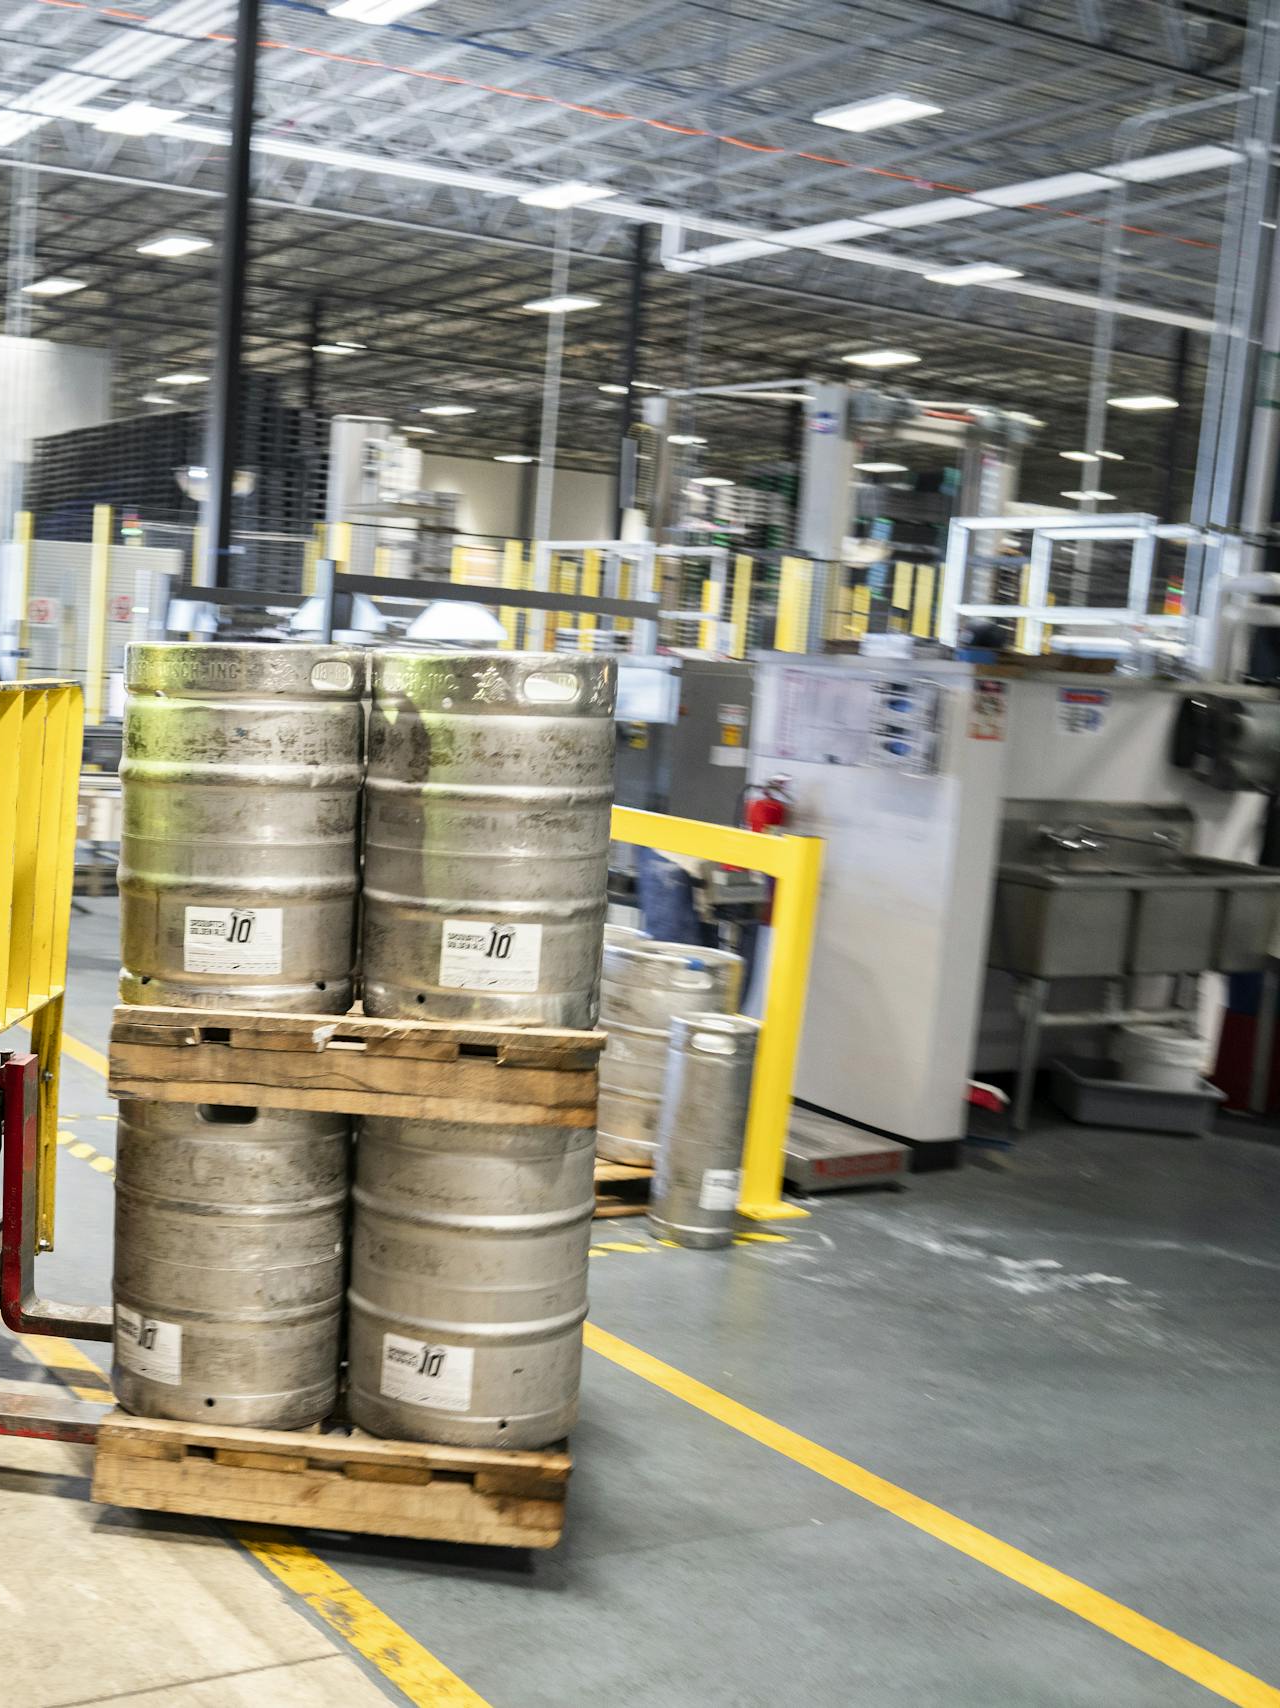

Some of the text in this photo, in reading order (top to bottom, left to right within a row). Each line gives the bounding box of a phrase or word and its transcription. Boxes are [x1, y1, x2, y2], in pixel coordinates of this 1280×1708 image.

[226, 914, 254, 943] 10
[485, 929, 514, 959] 10
[417, 1348, 446, 1377] 10
